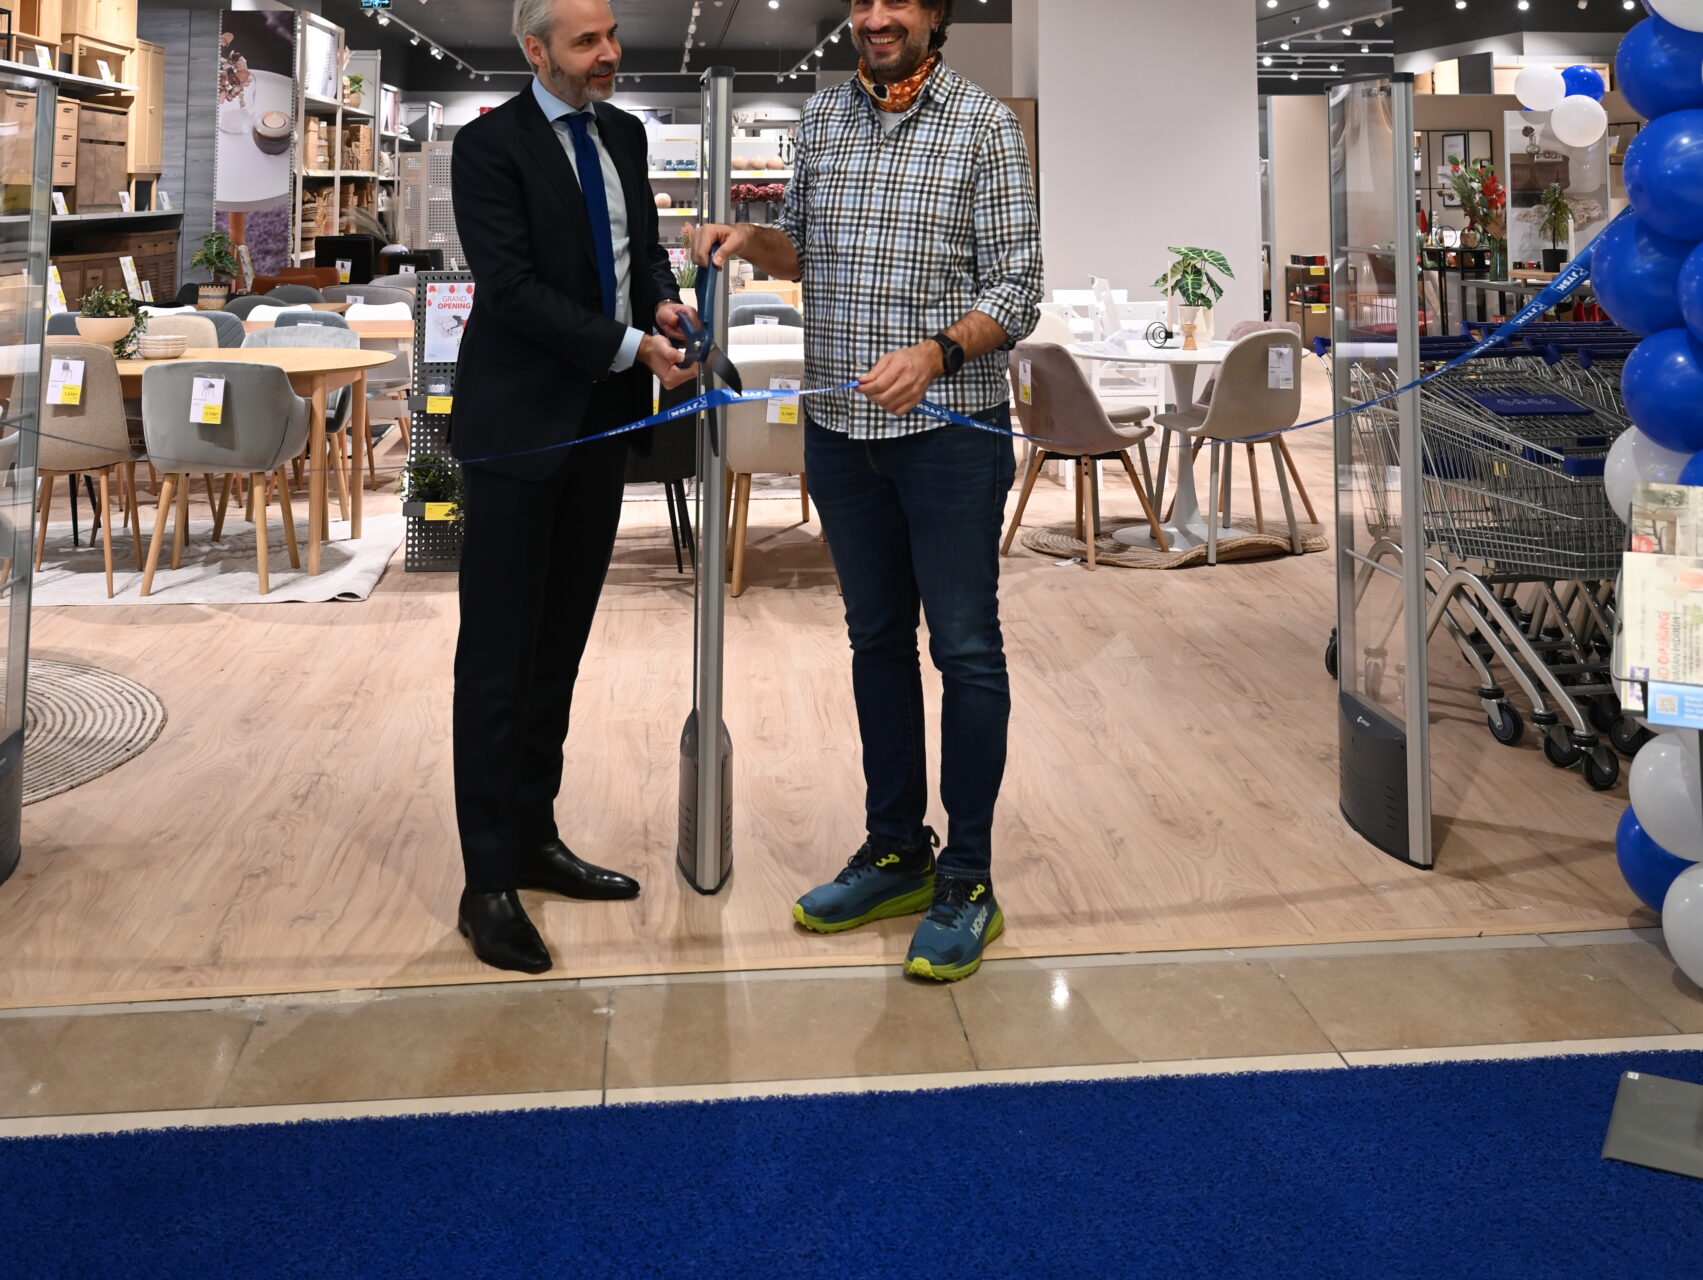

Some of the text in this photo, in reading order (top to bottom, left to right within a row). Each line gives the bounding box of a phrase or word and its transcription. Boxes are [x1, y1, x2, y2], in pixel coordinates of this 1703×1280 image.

[1556, 271, 1579, 292] JYSK
[1515, 307, 1538, 325] JYSK
[670, 402, 699, 417] JYSK
[970, 905, 988, 940] HOKA
